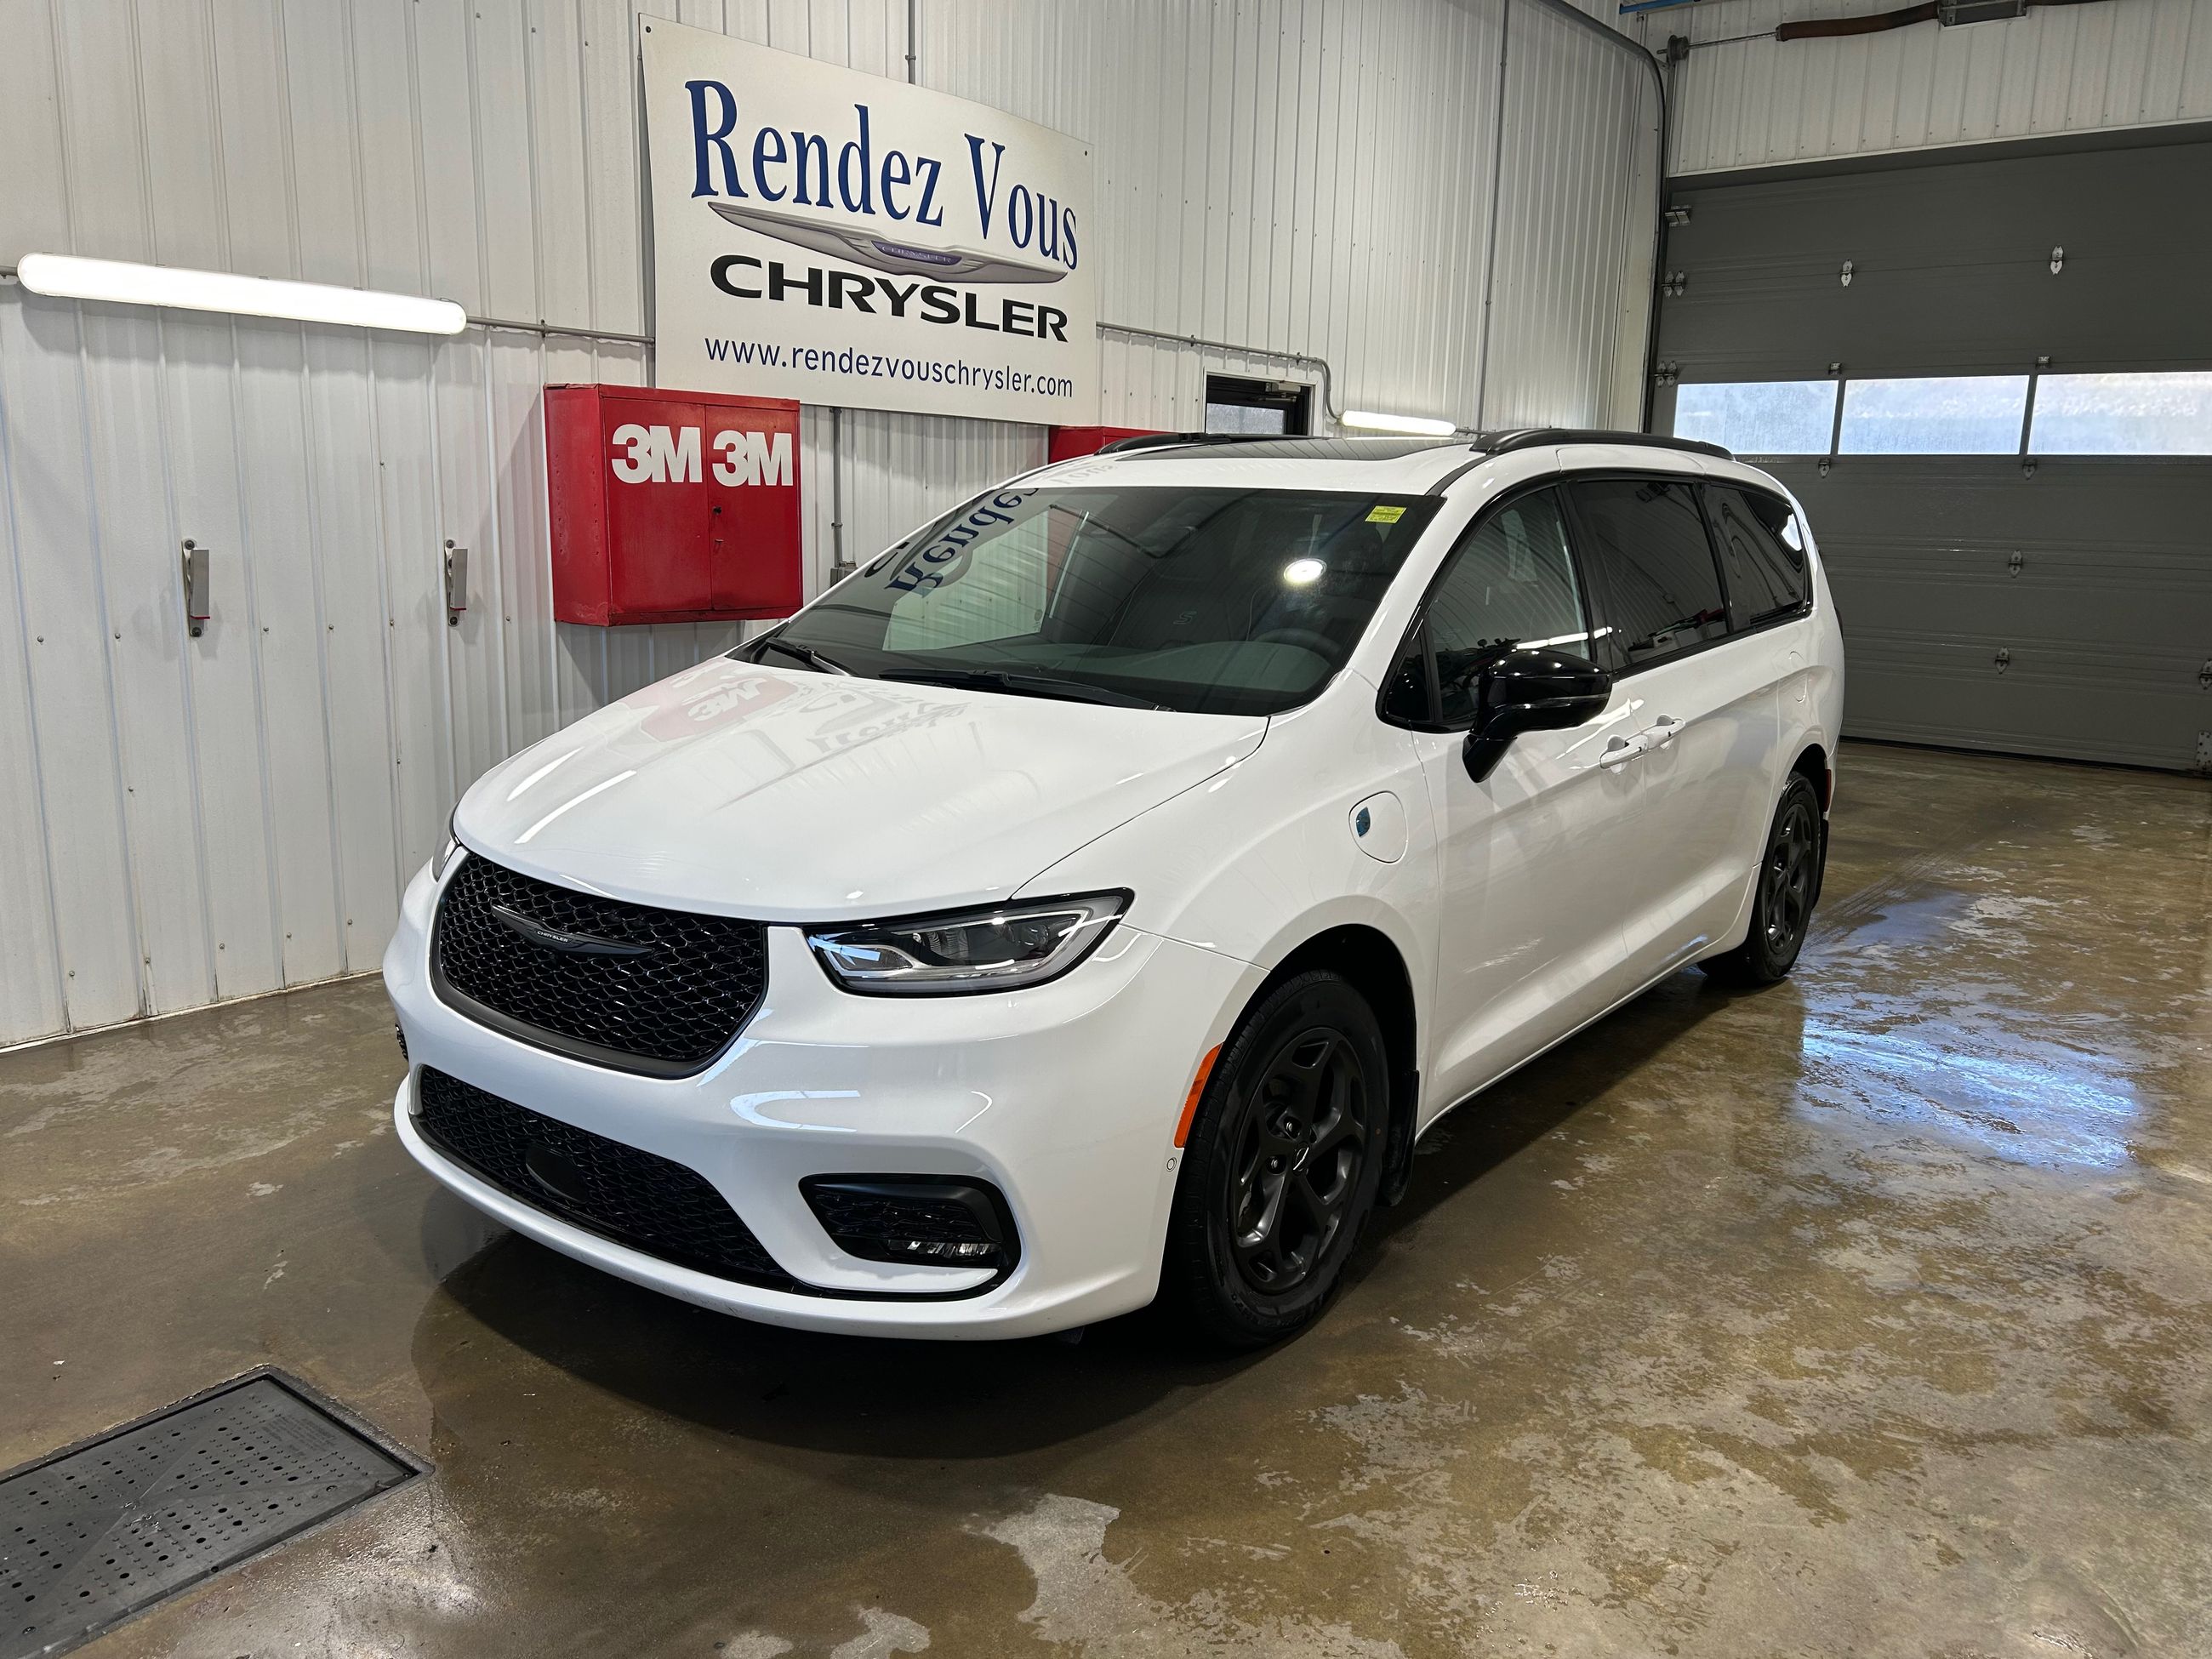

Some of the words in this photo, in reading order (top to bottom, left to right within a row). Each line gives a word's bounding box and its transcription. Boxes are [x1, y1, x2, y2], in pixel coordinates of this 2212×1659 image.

[684, 80, 944, 227] Rendez
[964, 133, 1078, 271] Vous
[710, 254, 1069, 343] CHRYSLER
[704, 338, 1074, 398] www.rendezvouschrysler.com
[611, 424, 703, 484] 3M
[712, 430, 794, 487] 3M
